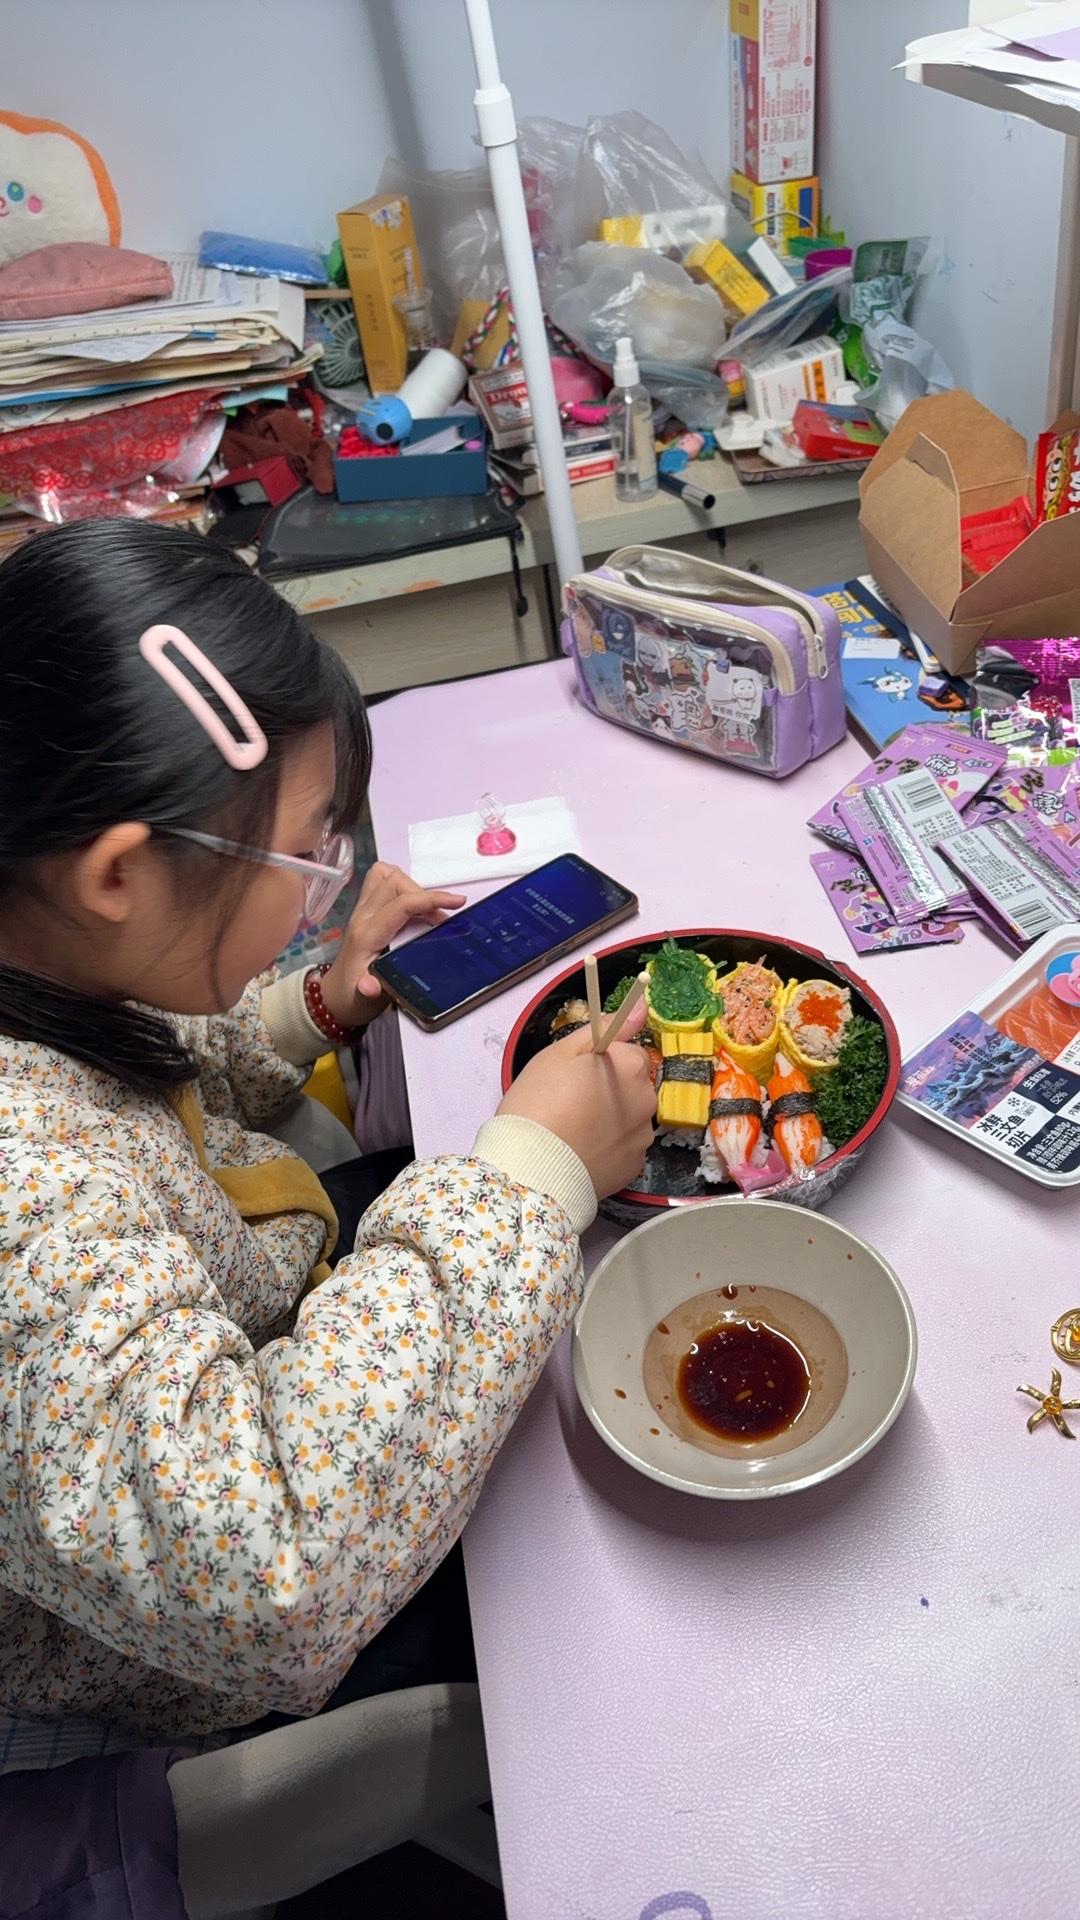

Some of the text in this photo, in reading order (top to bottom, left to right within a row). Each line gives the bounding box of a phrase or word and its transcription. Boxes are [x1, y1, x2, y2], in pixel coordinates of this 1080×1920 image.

[1048, 1090, 1069, 1107] 52%
[976, 1114, 1003, 1134] 冰鲜
[990, 1115, 1026, 1142] 三文鱼
[1005, 1131, 1031, 1150] 切片
